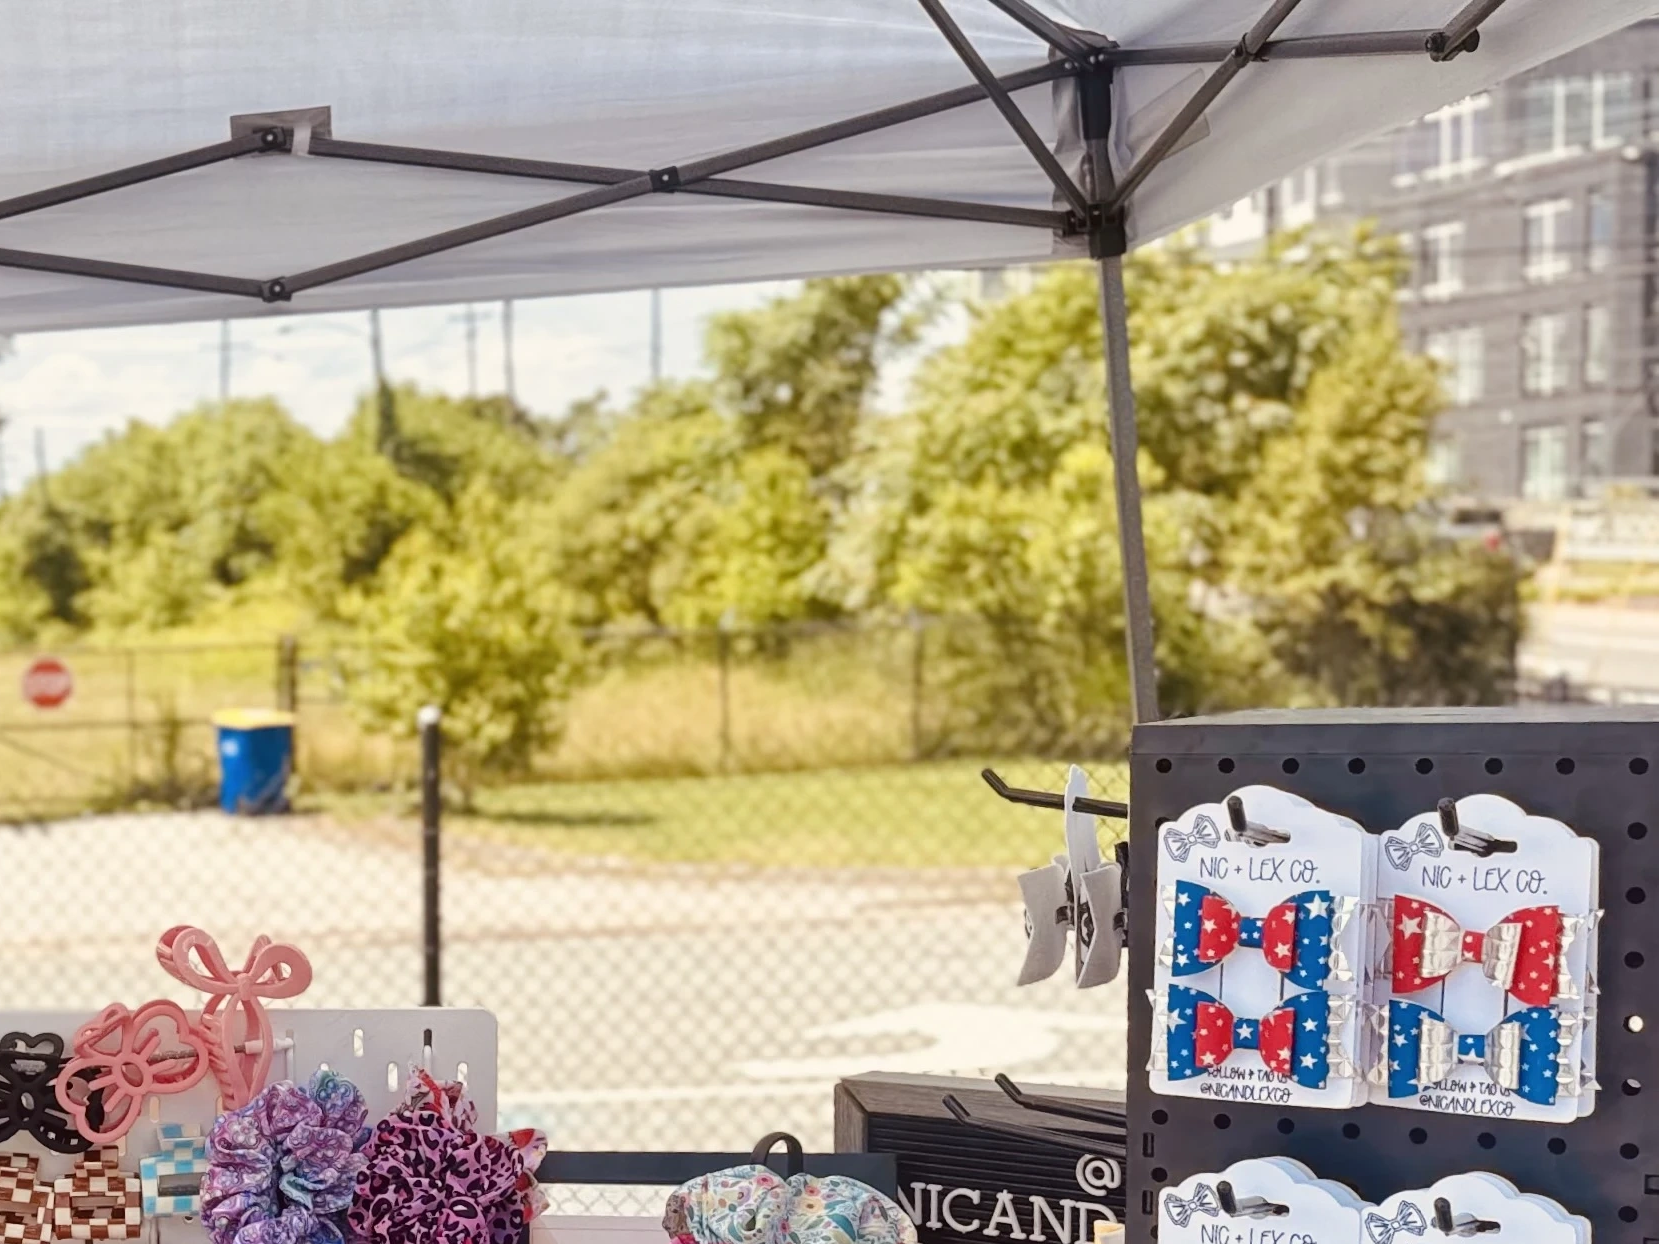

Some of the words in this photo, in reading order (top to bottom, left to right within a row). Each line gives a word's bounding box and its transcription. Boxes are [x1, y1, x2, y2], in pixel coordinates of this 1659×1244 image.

[1199, 857, 1228, 880] NIC
[1249, 858, 1283, 881] LEX
[1422, 865, 1451, 889] NIC
[1473, 867, 1512, 892] LEX
[1076, 1154, 1121, 1196] @
